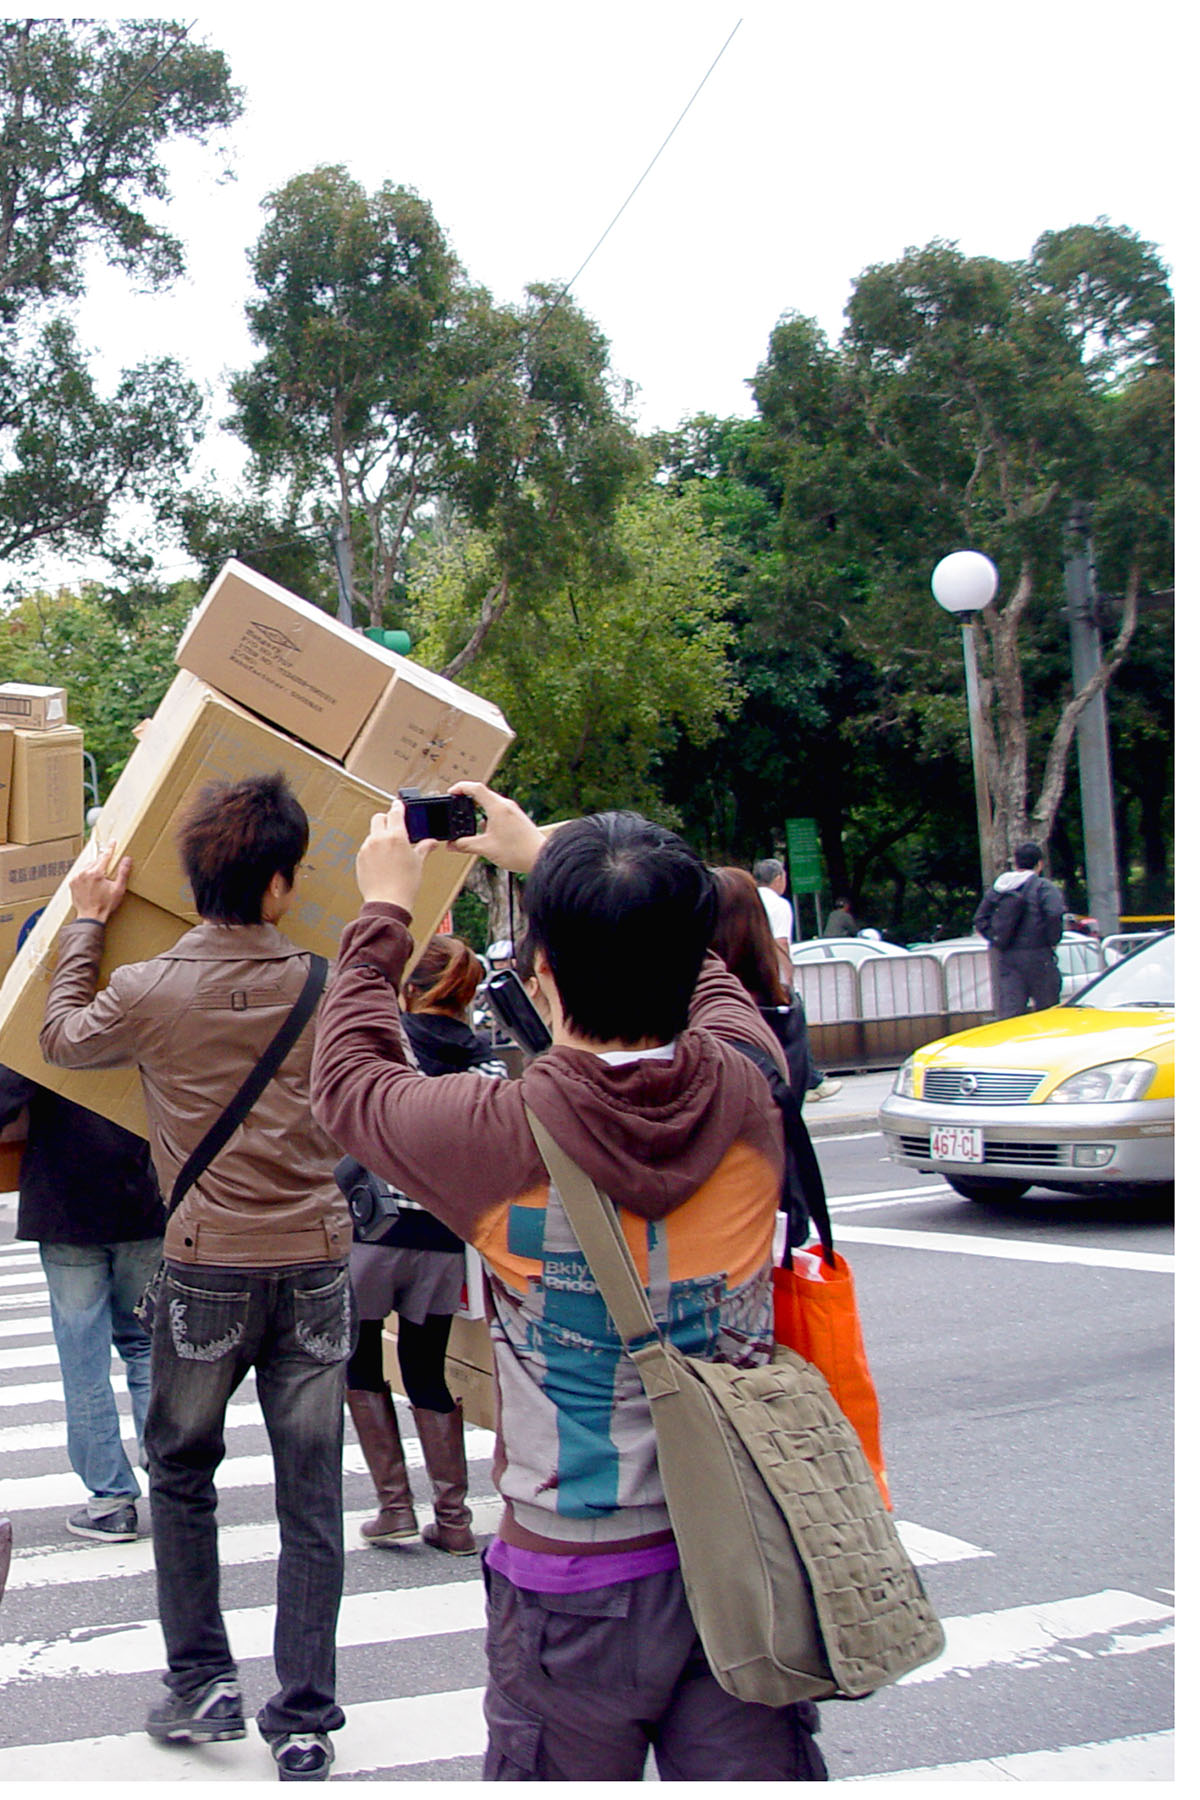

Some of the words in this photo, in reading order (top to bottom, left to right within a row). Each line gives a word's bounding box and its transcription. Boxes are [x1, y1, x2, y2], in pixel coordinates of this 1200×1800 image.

[932, 1134, 980, 1157] 467-CL
[545, 1260, 588, 1282] Bkly
[543, 1275, 597, 1295] Bridg
